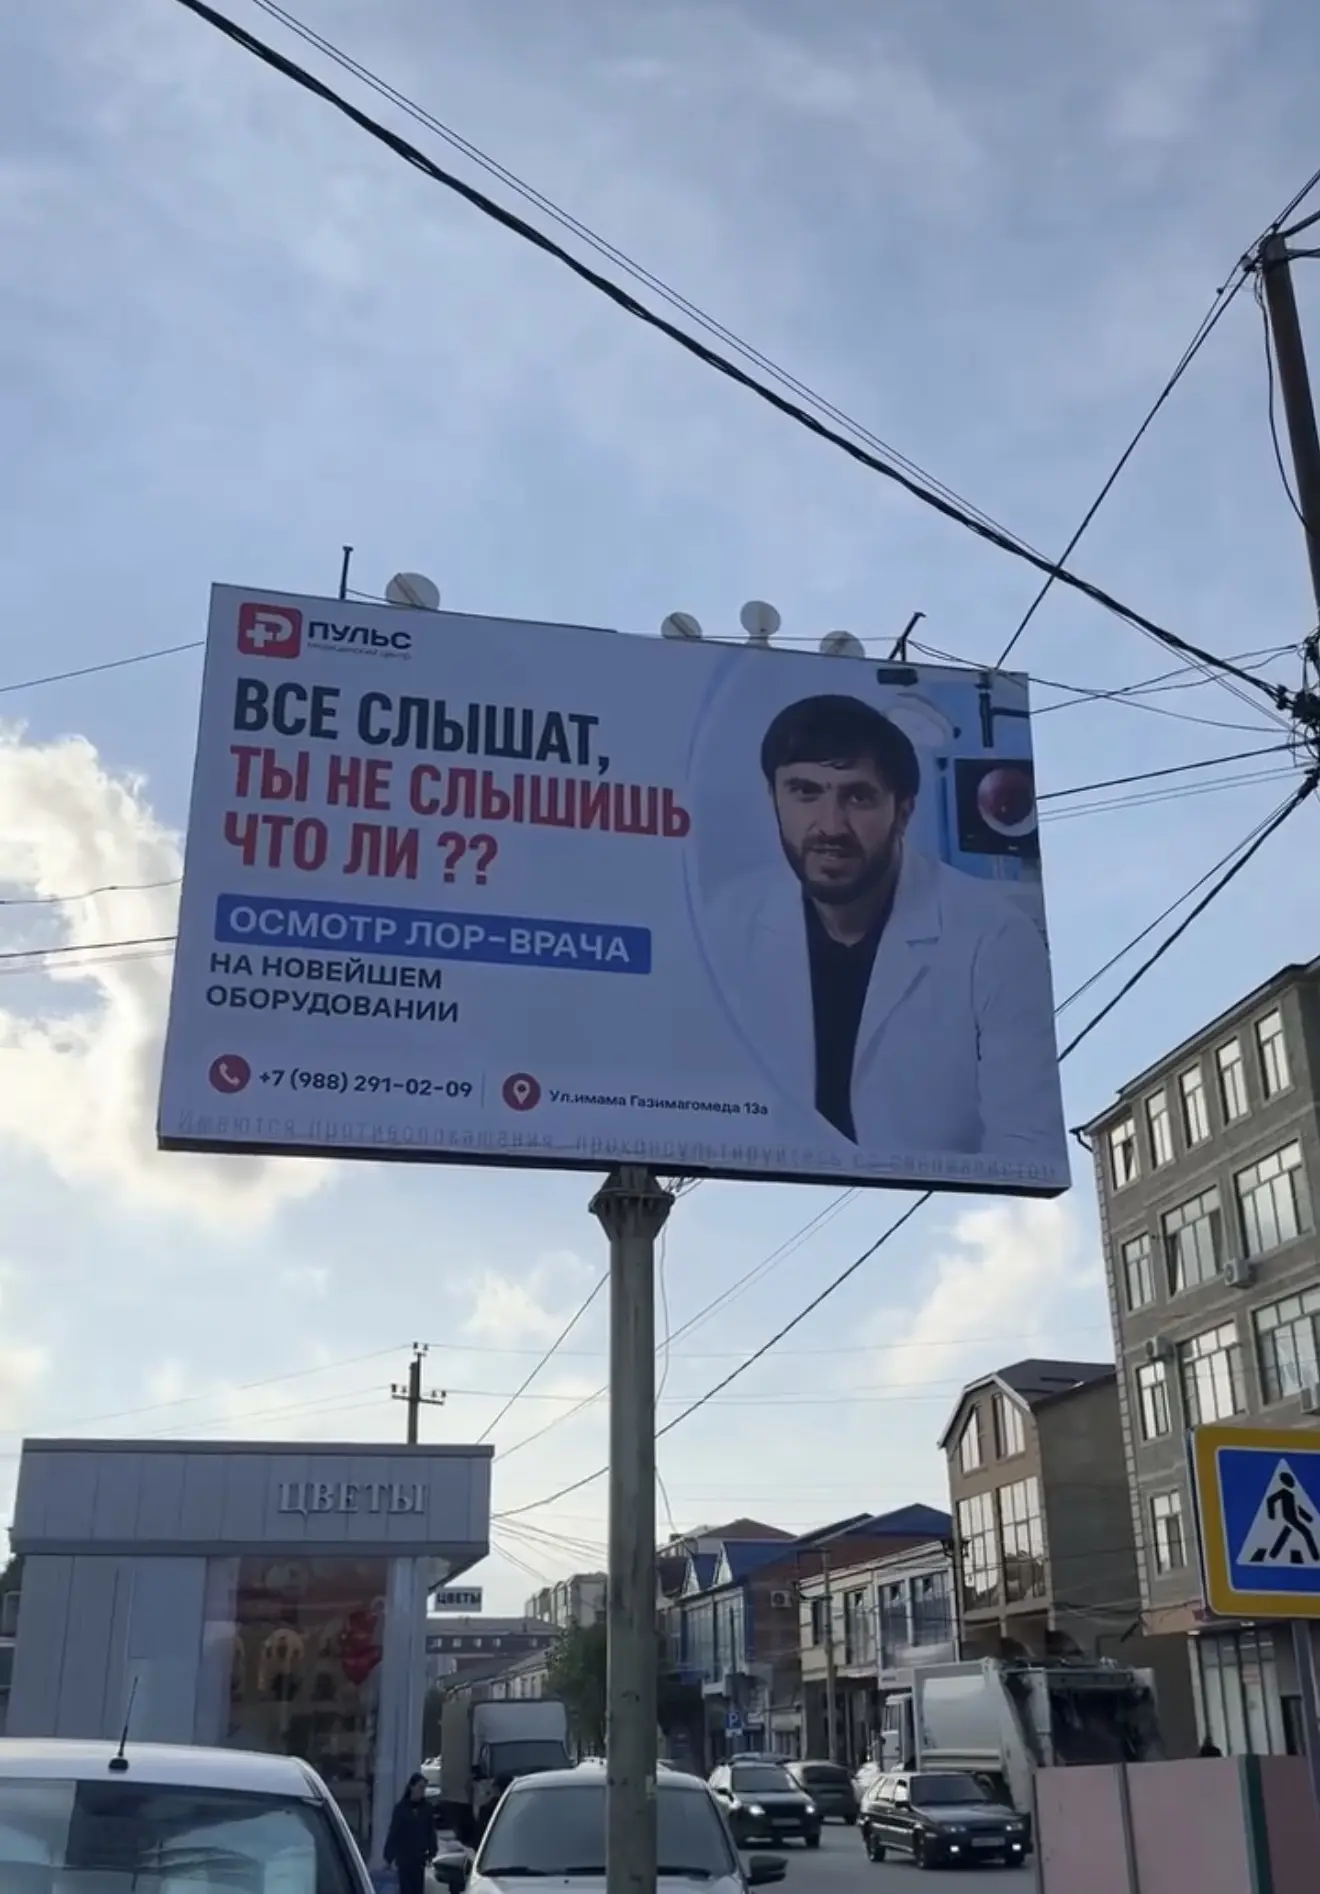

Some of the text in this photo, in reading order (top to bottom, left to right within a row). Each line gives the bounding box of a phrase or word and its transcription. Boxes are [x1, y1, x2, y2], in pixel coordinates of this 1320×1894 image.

[308, 620, 412, 650] ПУЛЬС
[234, 677, 610, 773] ВСЕ СЛЫШАТ,
[230, 744, 691, 838] ТЫ НЕ СЛЫШИШЬ
[224, 811, 498, 885] ЧТО ЛИ ??
[229, 906, 630, 963] ОСМОТР ЛОР-ВРАЧА
[210, 952, 442, 990] НА НОВЕЙШЕМ
[206, 985, 459, 1023] ОБОРУДОВАНИИ
[258, 1068, 473, 1098] +7 (988) 291-02-09
[630, 1094, 741, 1116] Газимагомеда
[278, 1482, 427, 1519] ЦВЕТЫ
[437, 1591, 482, 1606] ЦВЕТЫ
